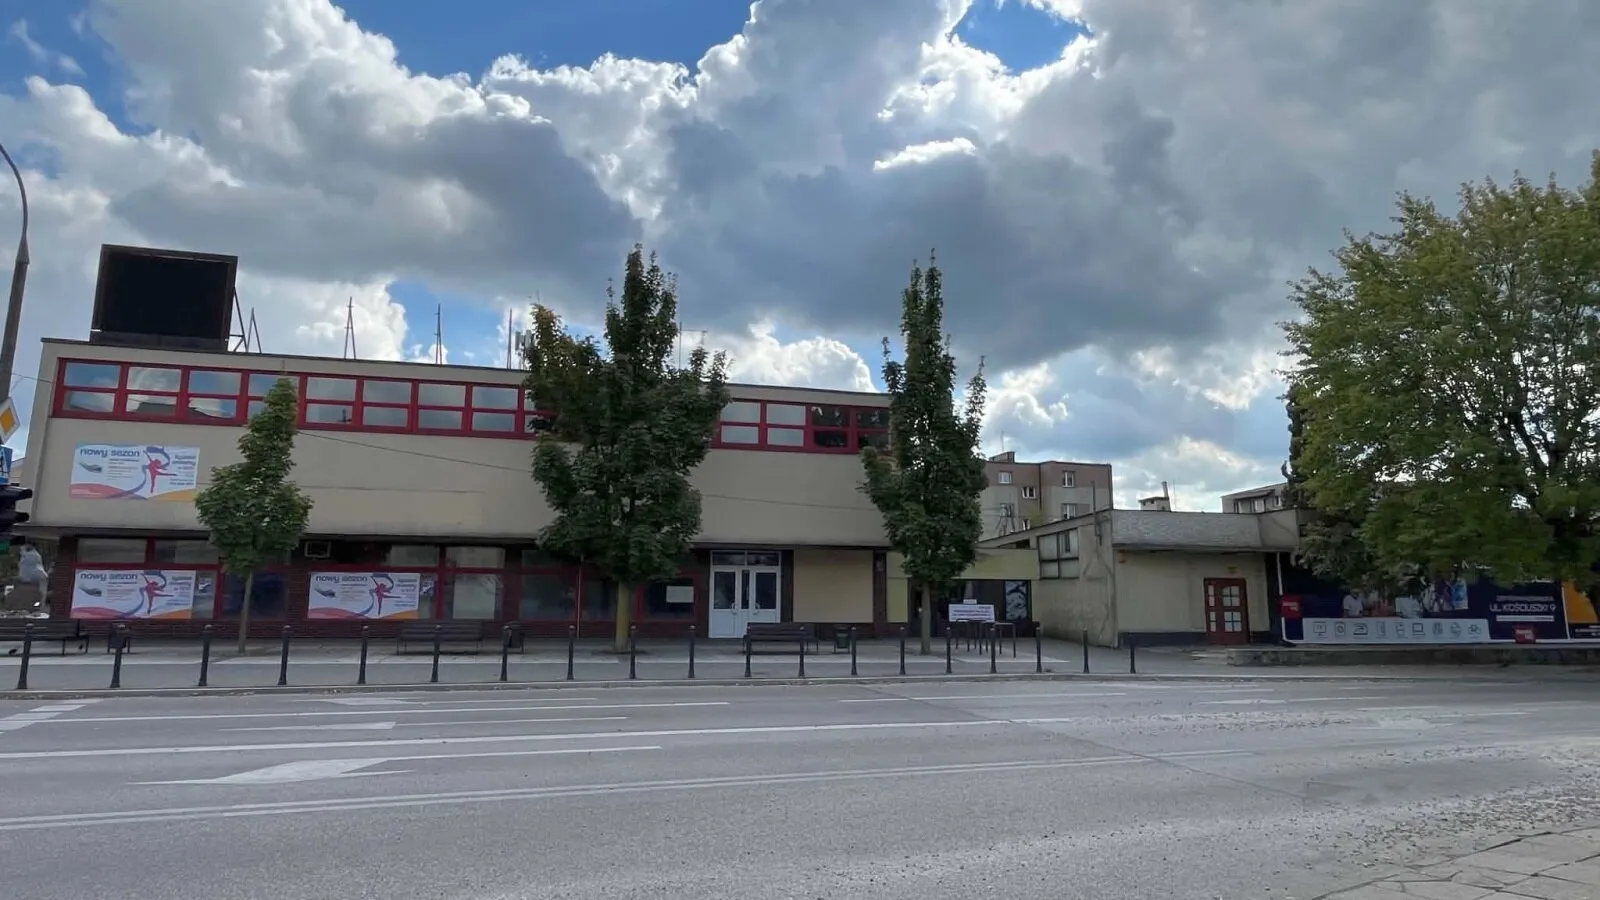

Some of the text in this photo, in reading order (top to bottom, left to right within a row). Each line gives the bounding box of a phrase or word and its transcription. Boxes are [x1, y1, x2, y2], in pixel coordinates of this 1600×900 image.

[80, 448, 140, 458] nowy sezon
[80, 573, 138, 582] nowy sezon
[315, 575, 340, 583] nowy
